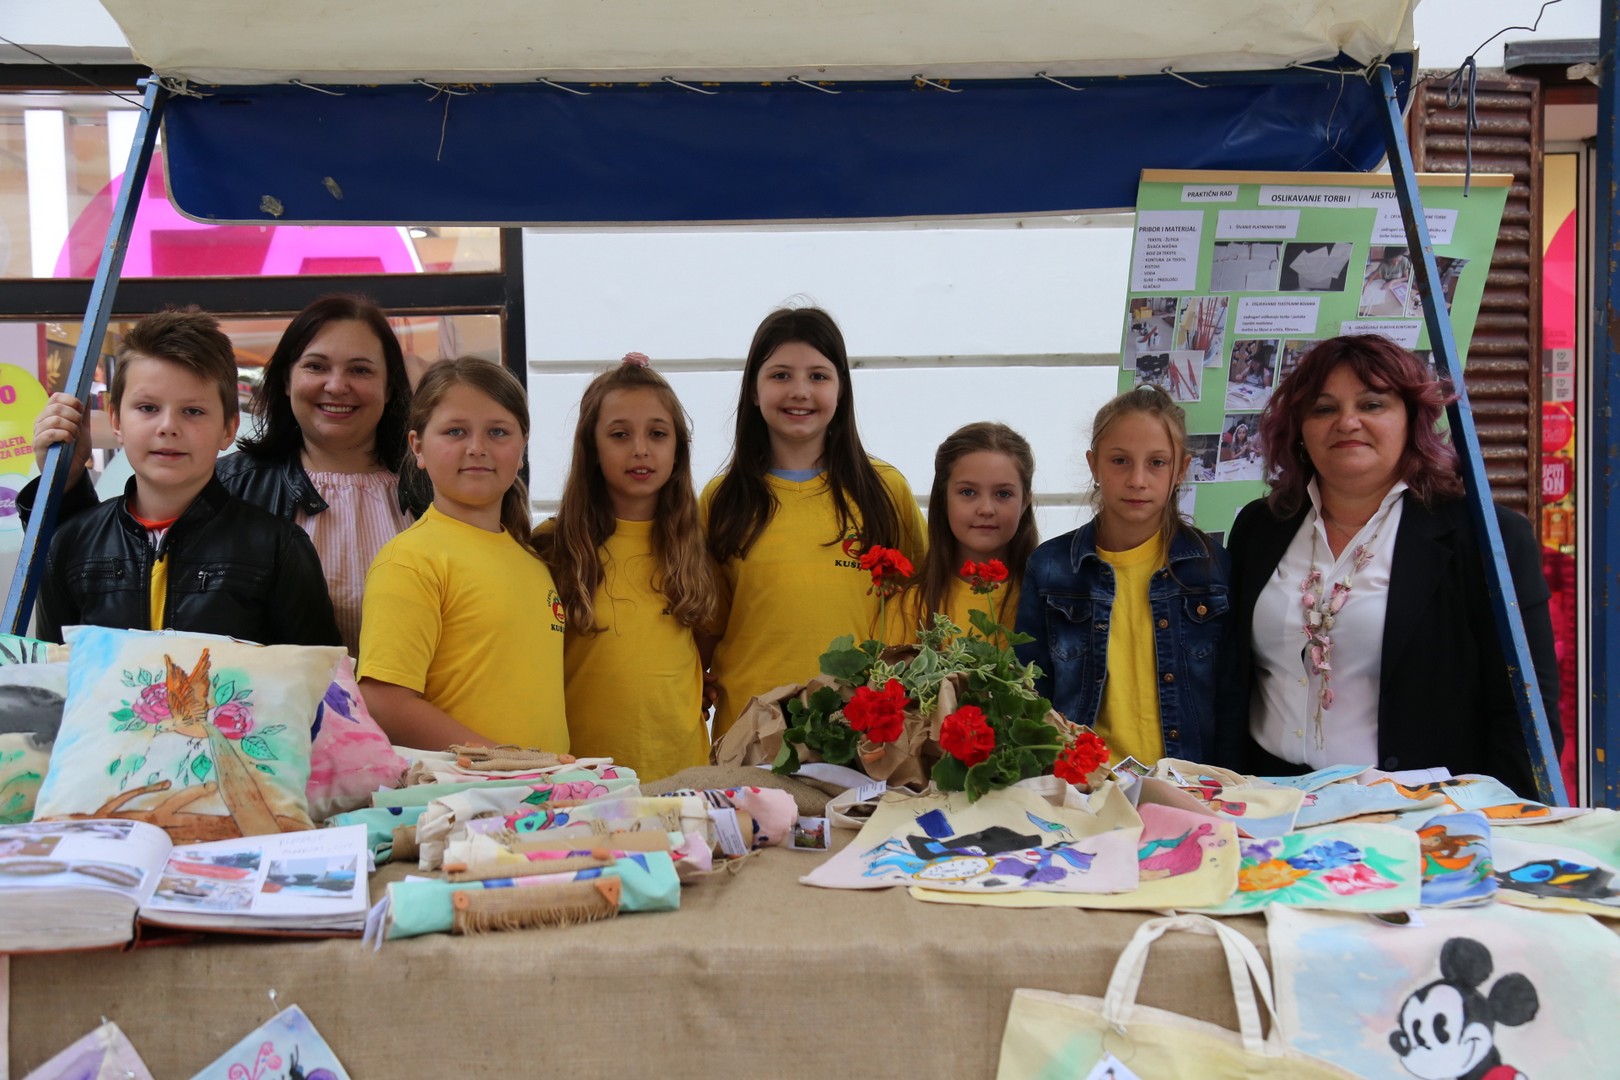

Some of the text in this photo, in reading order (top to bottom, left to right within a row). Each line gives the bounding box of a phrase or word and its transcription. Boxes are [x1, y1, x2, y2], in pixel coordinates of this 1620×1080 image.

[1187, 190, 1218, 198] PRAKTIČNI
[1271, 194, 1322, 202] OSLIKAVANJE
[1324, 194, 1346, 202] TORBI
[14, 445, 33, 457] BEB
